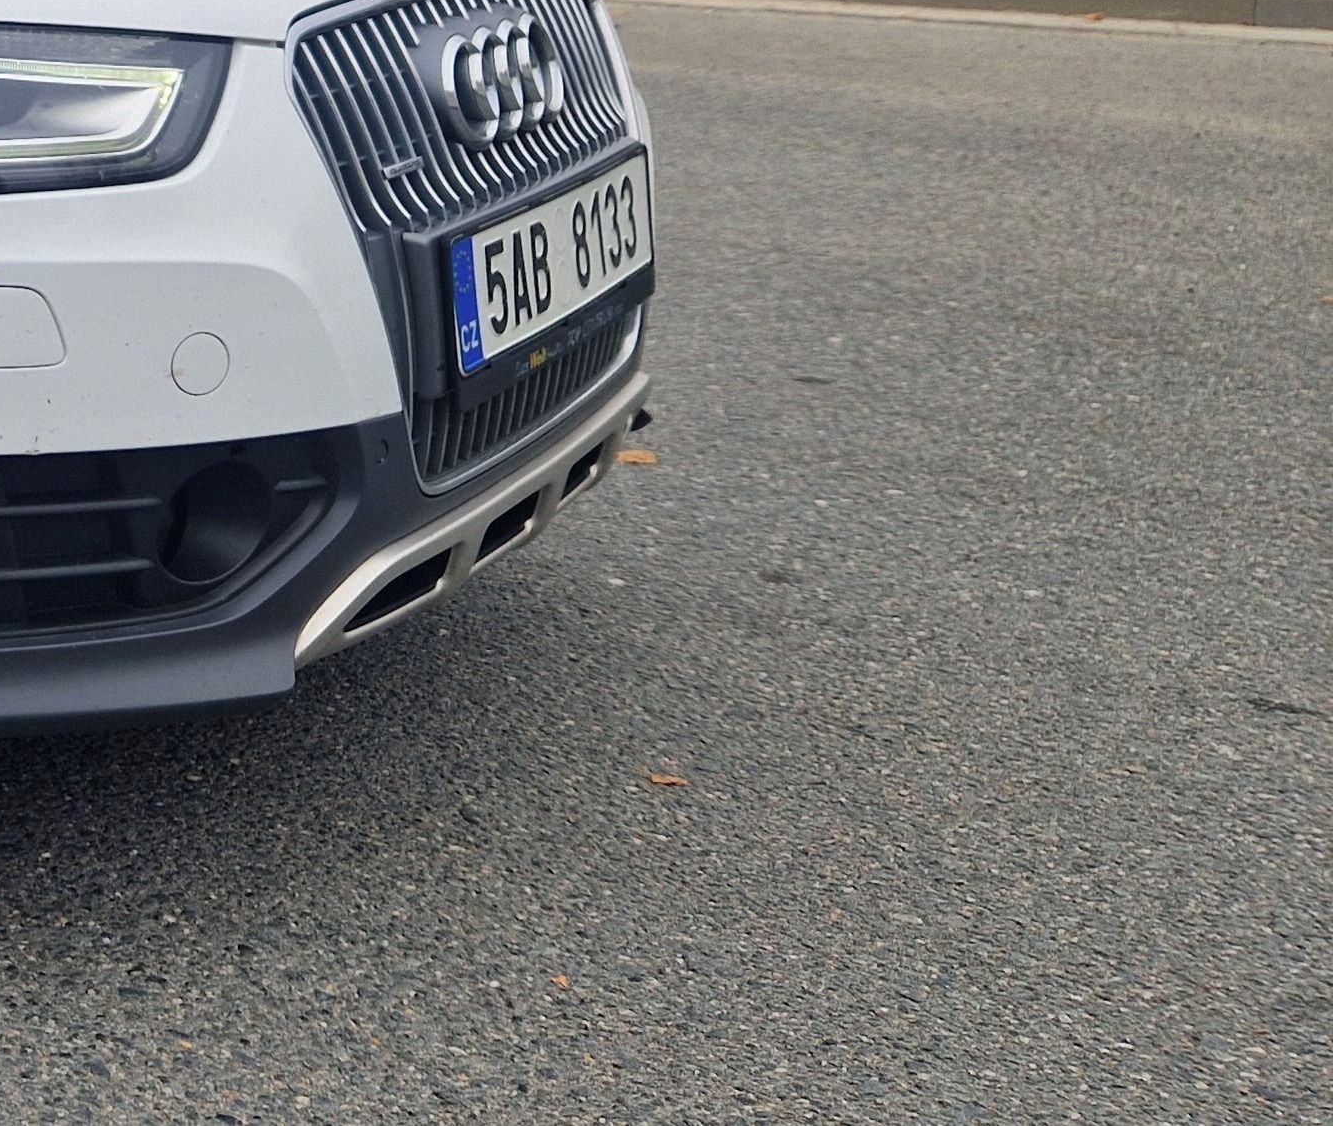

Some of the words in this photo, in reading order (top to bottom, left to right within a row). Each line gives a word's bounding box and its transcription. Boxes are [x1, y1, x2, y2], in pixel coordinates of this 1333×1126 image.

[484, 221, 552, 335] 5AB
[572, 175, 638, 289] 8133
[461, 320, 480, 354] CZ
